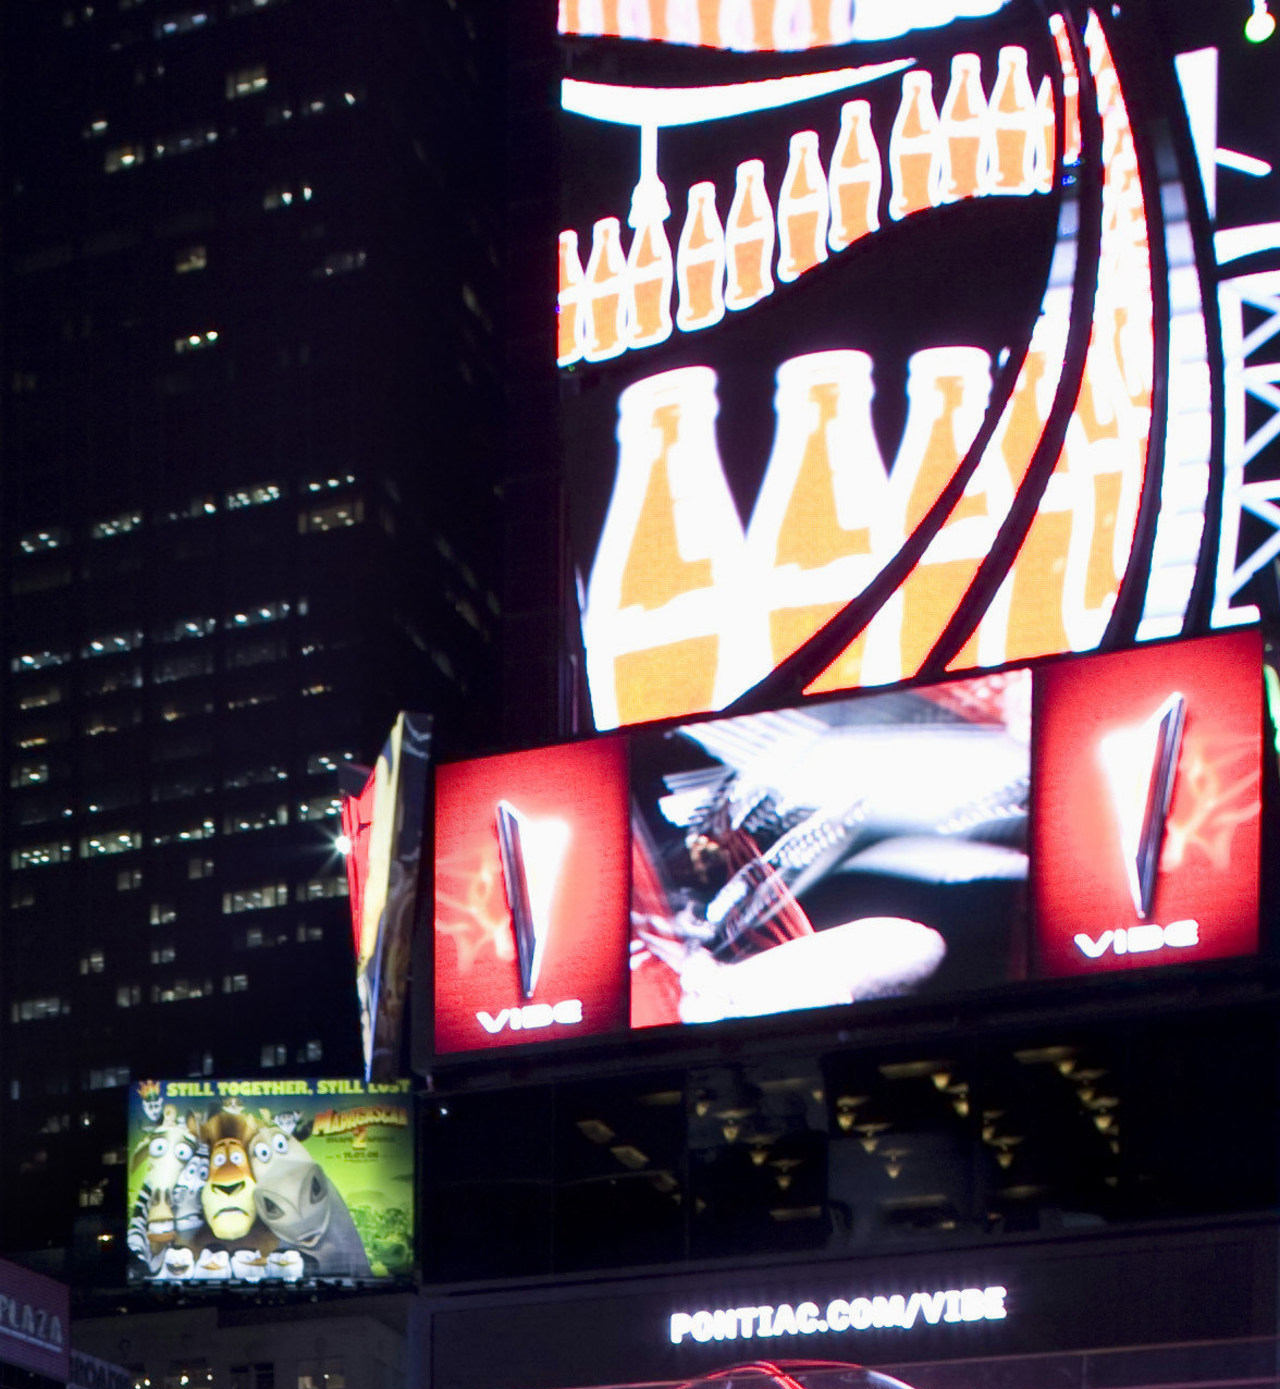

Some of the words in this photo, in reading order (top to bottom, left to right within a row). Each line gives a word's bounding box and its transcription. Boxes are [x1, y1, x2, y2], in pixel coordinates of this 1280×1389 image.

[1074, 919, 1199, 958] VIBE
[475, 999, 582, 1034] VIBE
[166, 1081, 214, 1097] STILL
[217, 1080, 313, 1096] TOGETHER.
[317, 1080, 364, 1095] STILL
[670, 1286, 1007, 1344] PONTIAC.COM/VIBE
